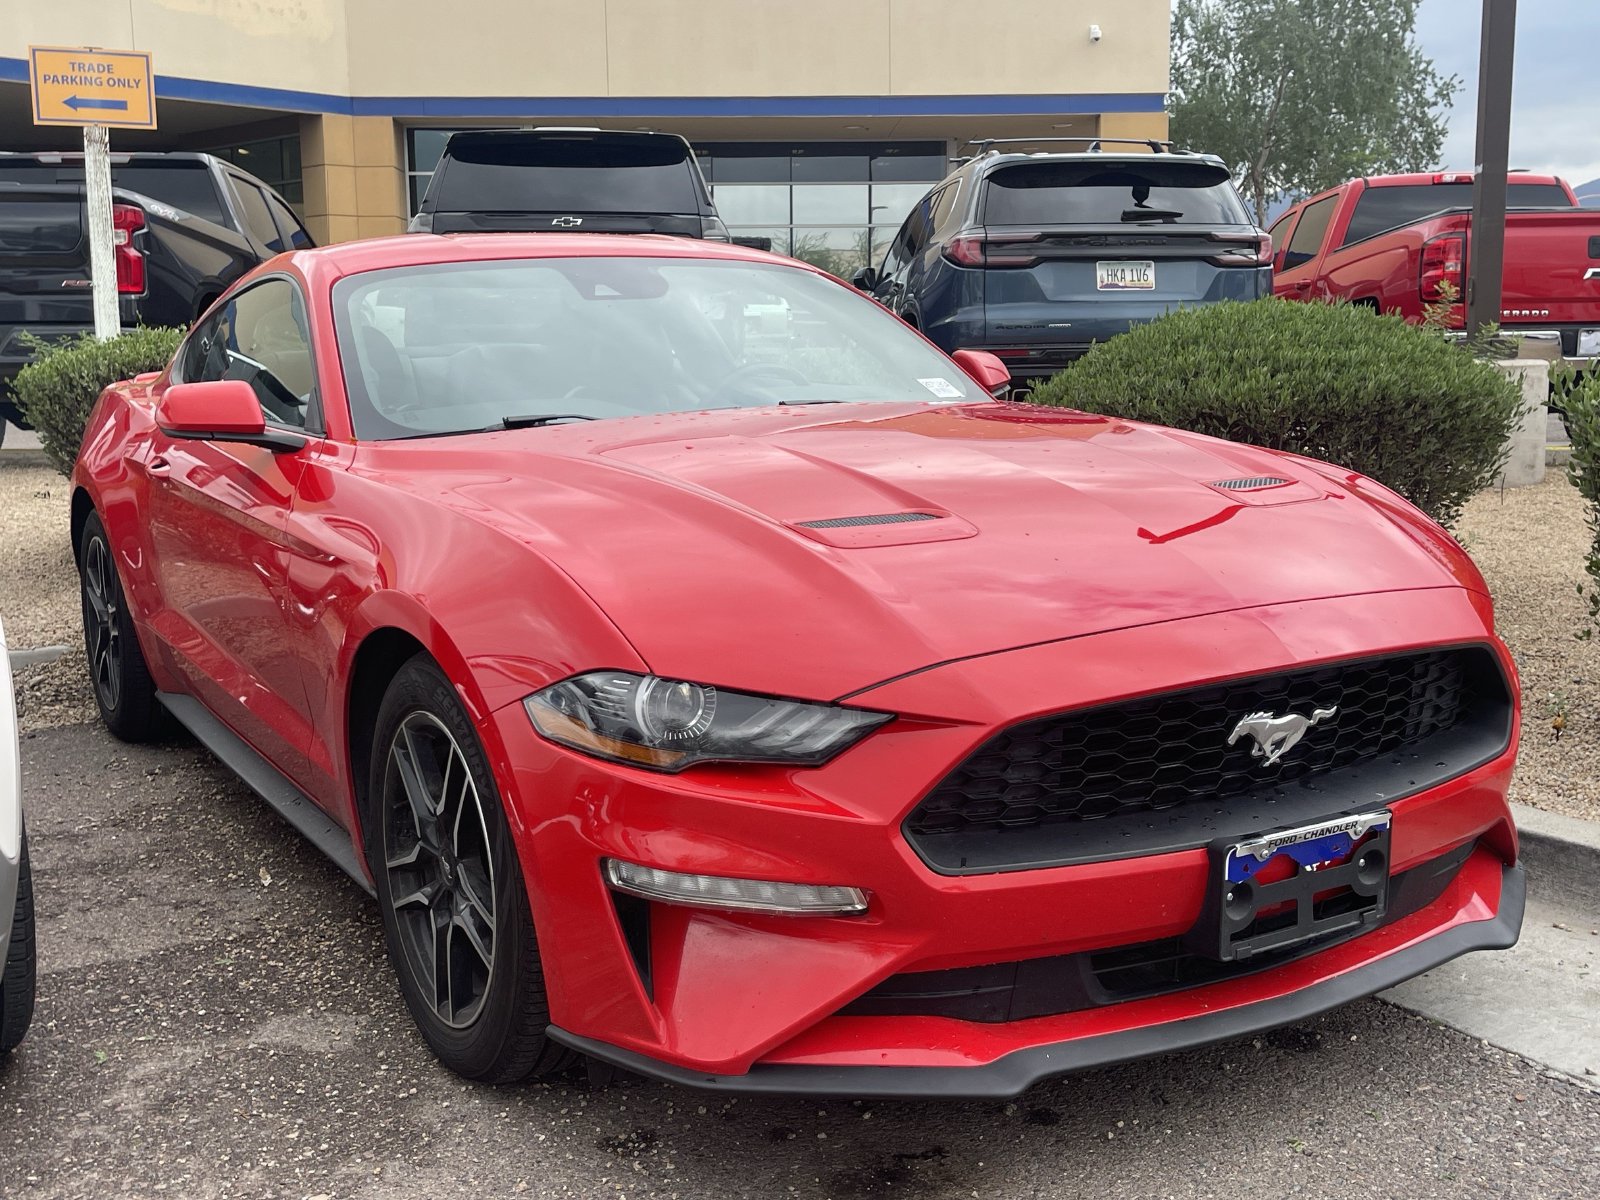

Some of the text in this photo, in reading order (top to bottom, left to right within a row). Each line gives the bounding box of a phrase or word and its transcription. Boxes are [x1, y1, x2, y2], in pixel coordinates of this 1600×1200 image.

[69, 61, 114, 74] TRADE
[43, 74, 142, 89] PARKING ONLY
[1106, 268, 1126, 282] HKA
[1500, 309, 1549, 317] ERADO
